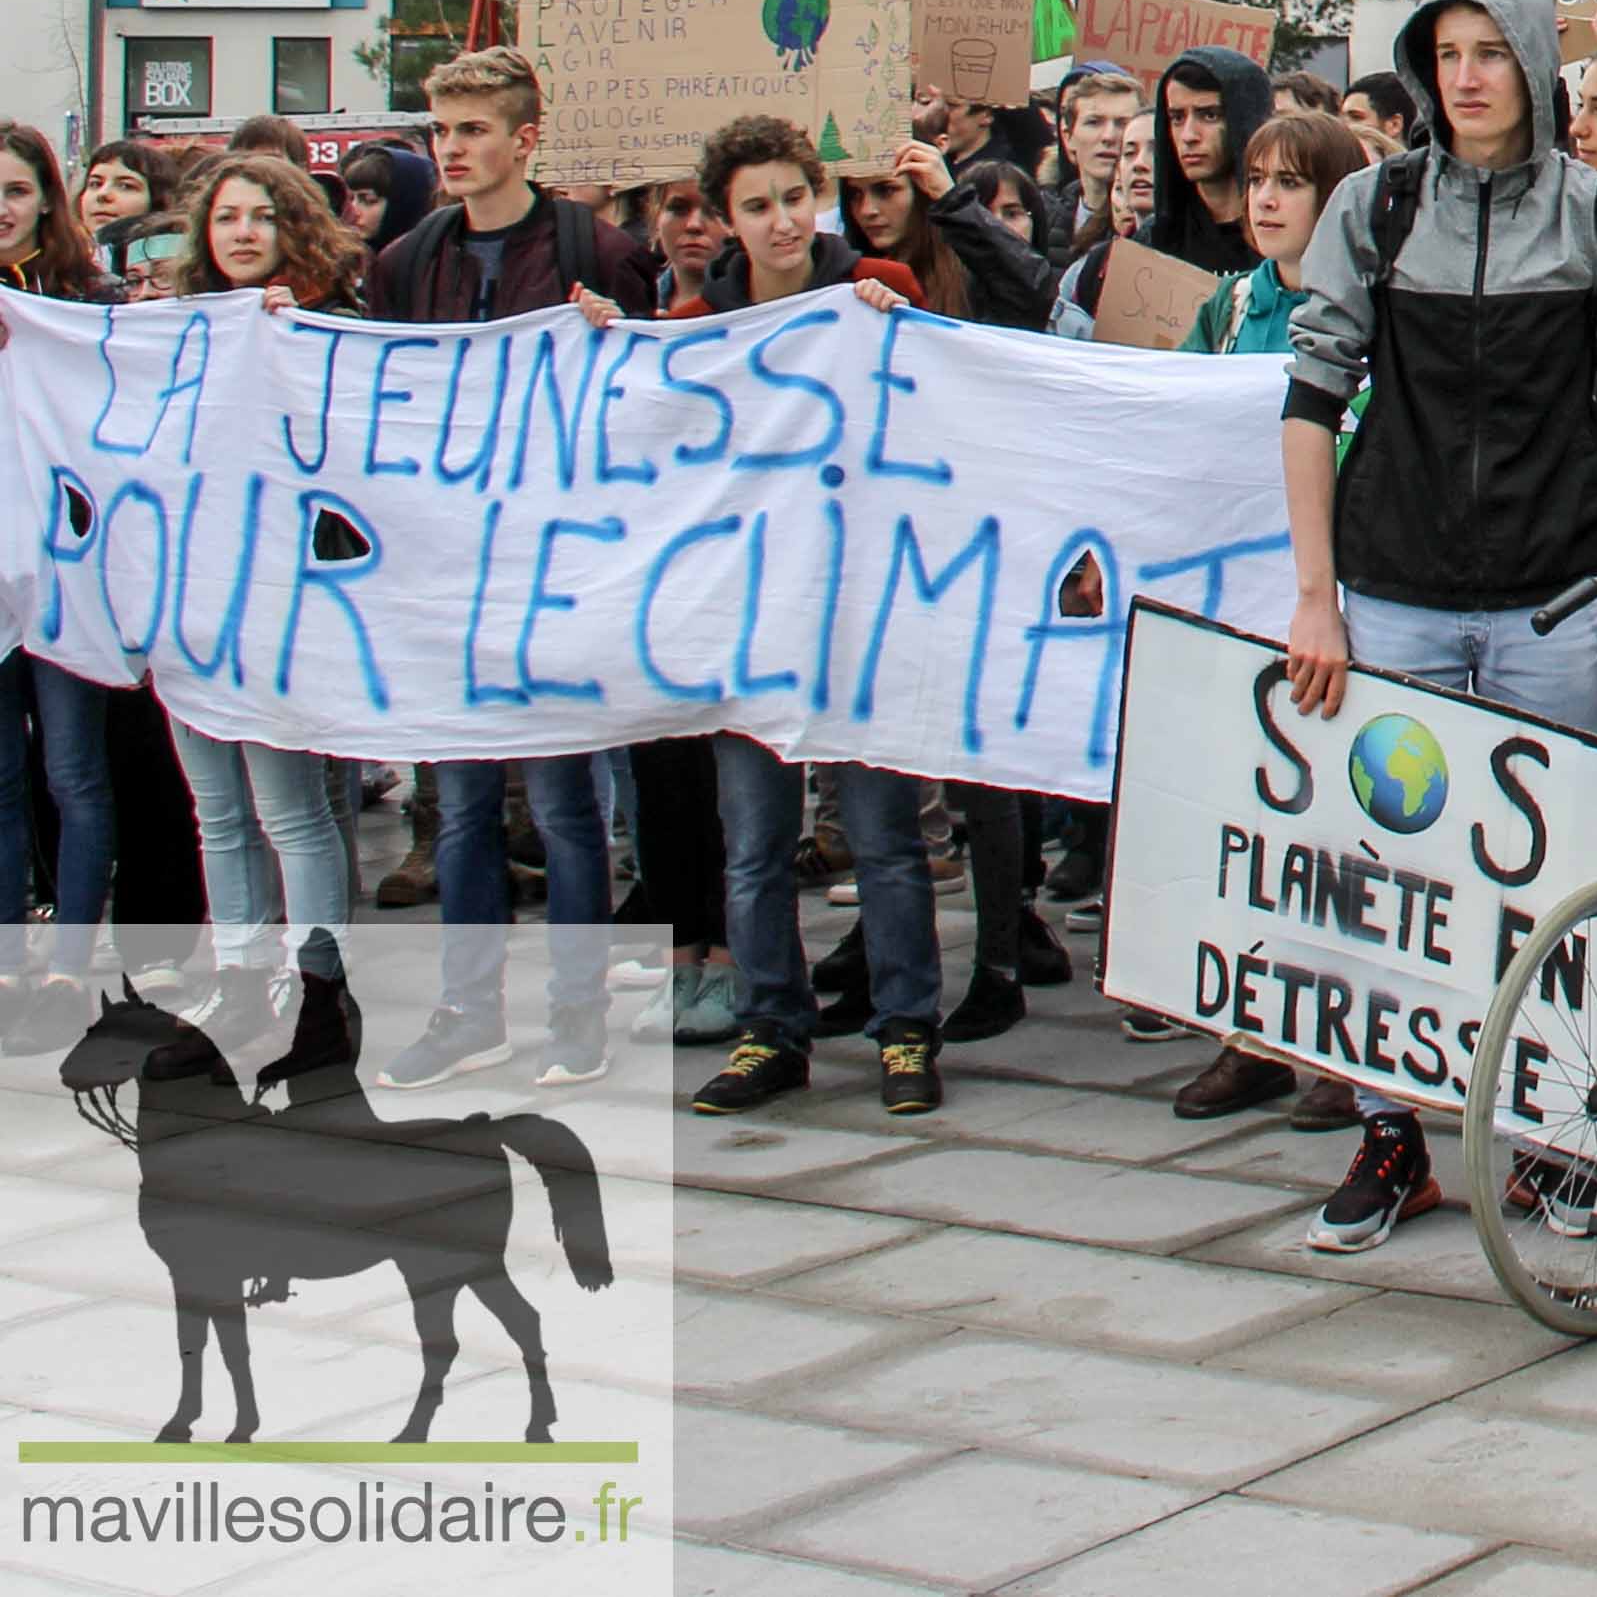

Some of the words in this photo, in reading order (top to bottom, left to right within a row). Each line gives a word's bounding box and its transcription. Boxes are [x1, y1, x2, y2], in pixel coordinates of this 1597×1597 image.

[536, 17, 688, 48] L'AVENIR
[924, 14, 970, 36] MON
[975, 15, 1029, 36] RHUM
[534, 47, 616, 75] AGIR
[145, 82, 192, 107] BOX
[540, 76, 650, 106] NAPPES
[665, 72, 810, 99] PHRÉATIQUES
[618, 131, 704, 151] ENSEMB
[93, 305, 211, 464] LA
[283, 303, 961, 494] JEUNESSE
[44, 465, 390, 710] POUR
[464, 499, 626, 708] LE
[636, 465, 1292, 769] CLIMAT
[1217, 822, 1456, 966] PLANÈTE
[1495, 904, 1588, 1011] EN
[1196, 939, 1551, 1126] DÉTRESSE
